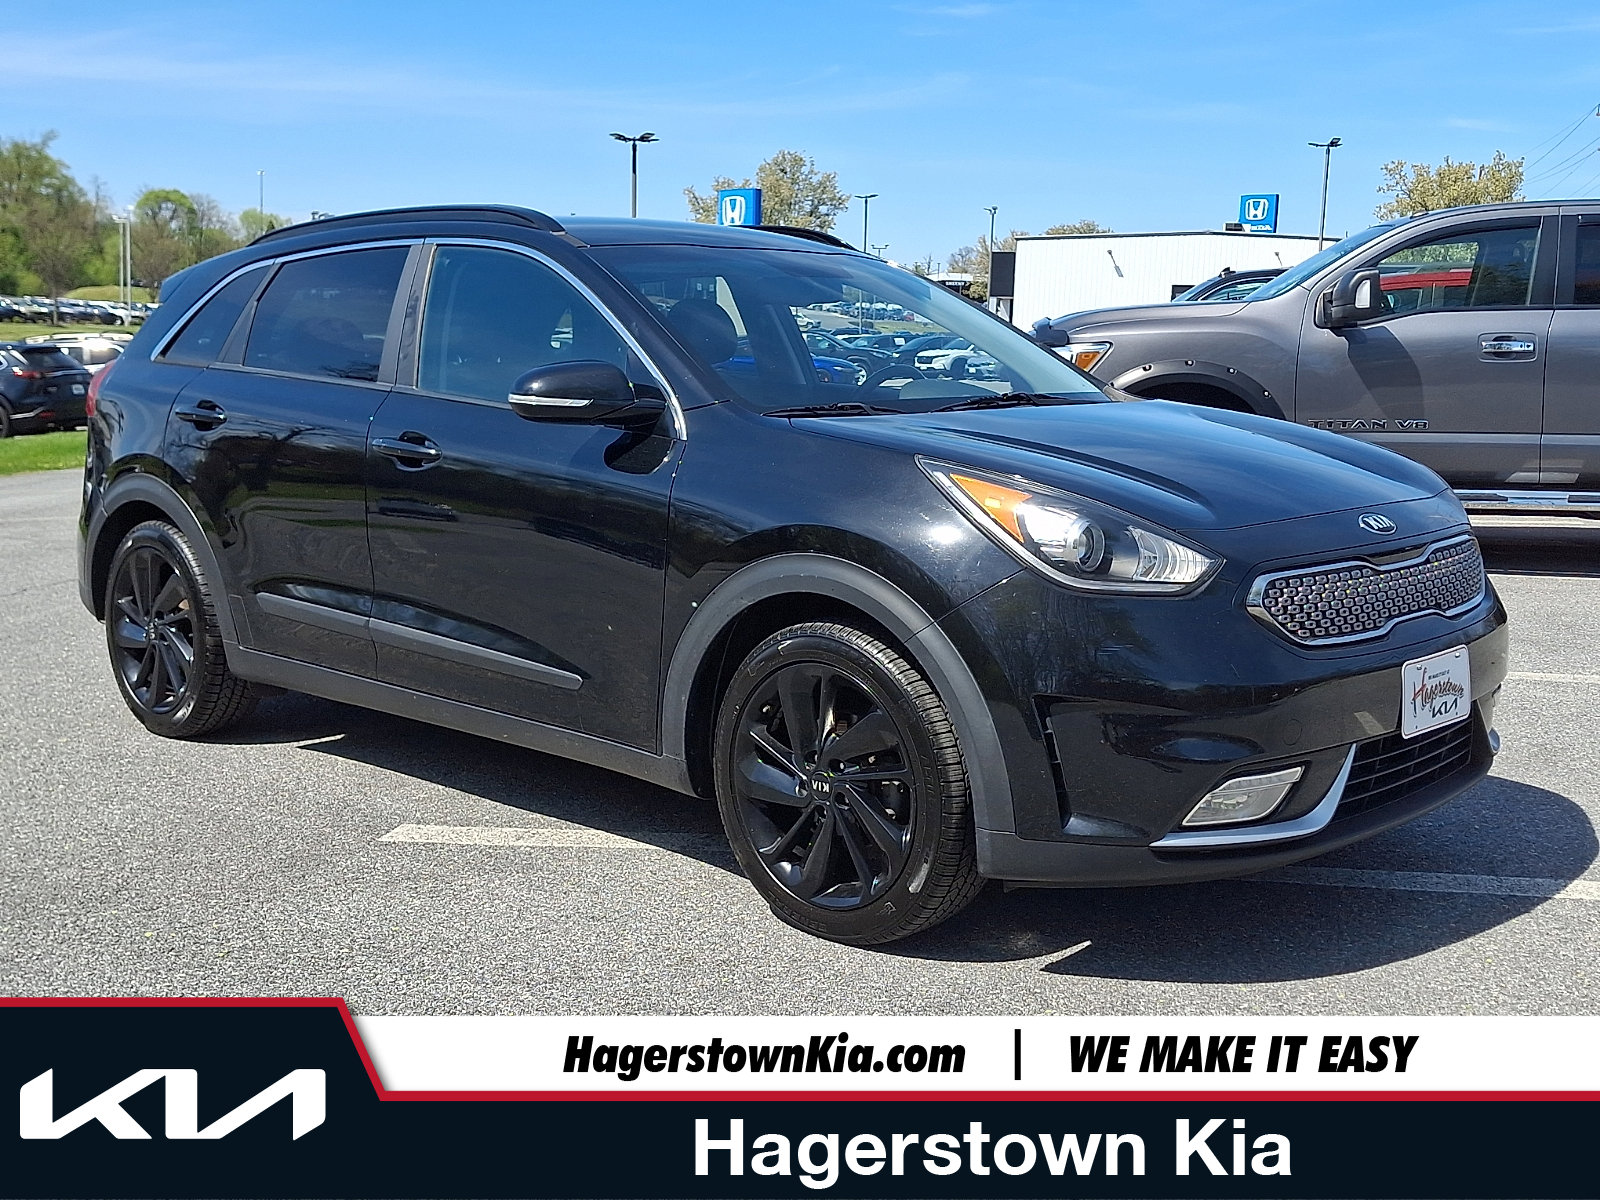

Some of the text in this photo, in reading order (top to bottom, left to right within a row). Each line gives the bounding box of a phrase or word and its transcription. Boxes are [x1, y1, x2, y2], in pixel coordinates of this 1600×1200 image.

[1308, 419, 1429, 429] TITAN V8
[1362, 514, 1395, 530] KIA
[1411, 667, 1464, 718] Hagerstown
[811, 780, 830, 793] KIA
